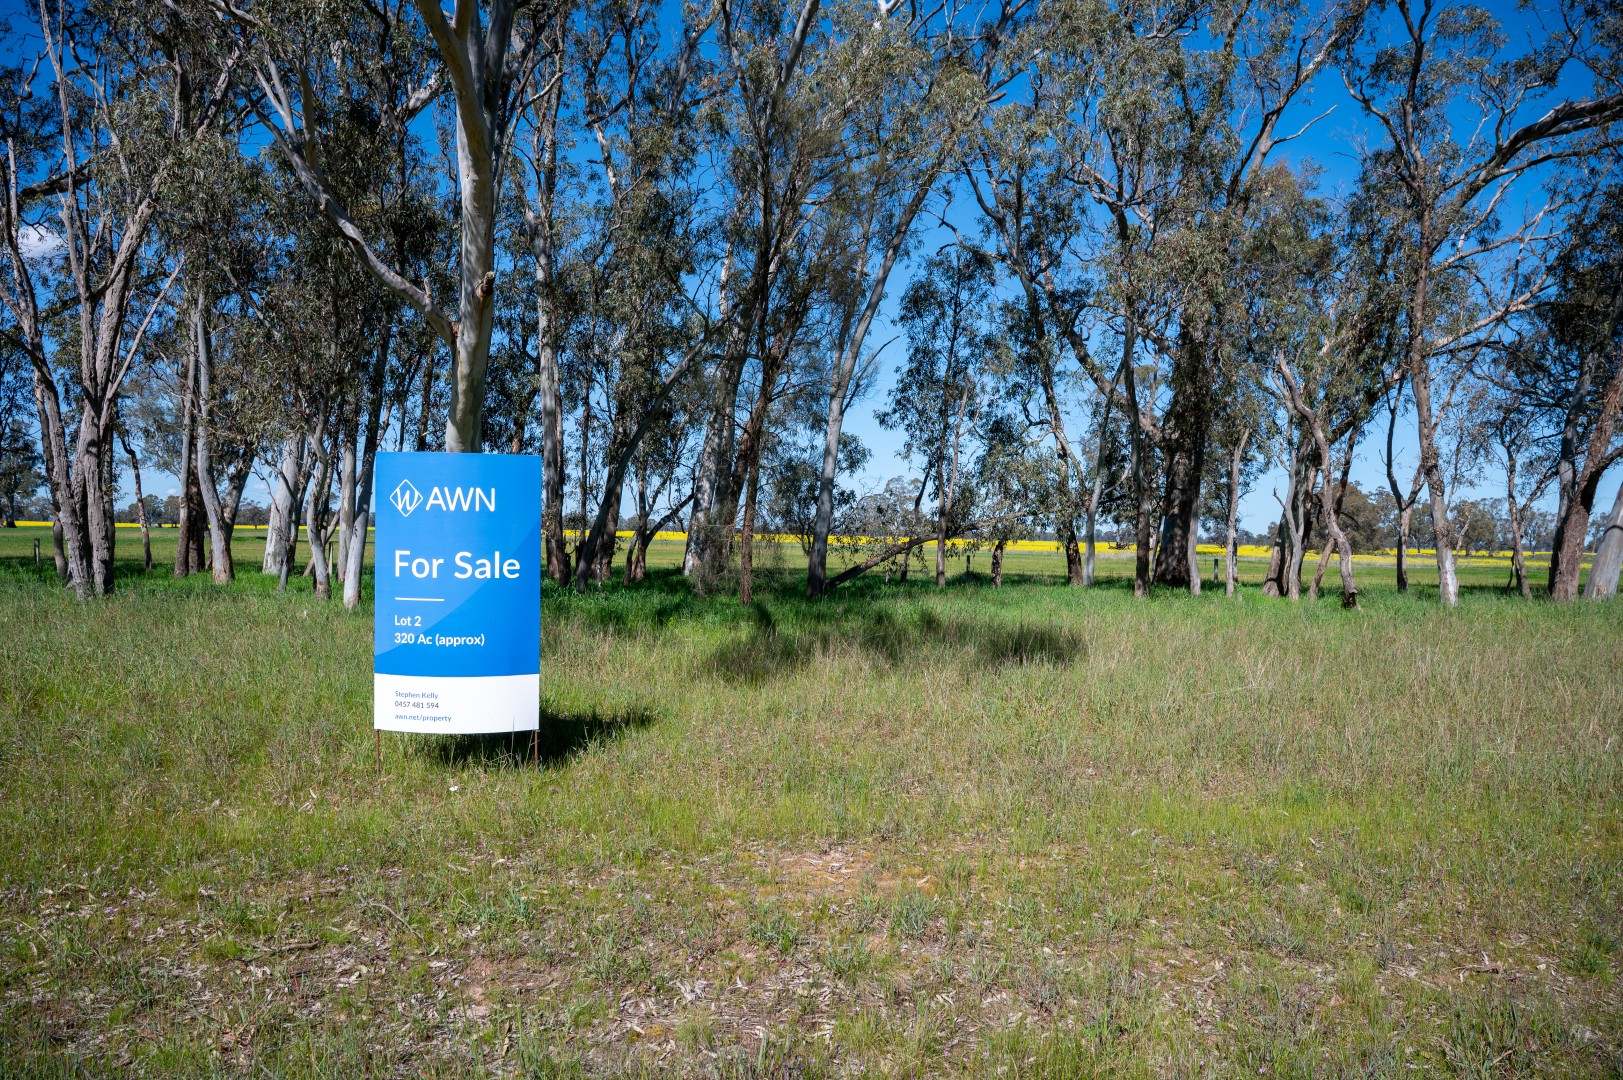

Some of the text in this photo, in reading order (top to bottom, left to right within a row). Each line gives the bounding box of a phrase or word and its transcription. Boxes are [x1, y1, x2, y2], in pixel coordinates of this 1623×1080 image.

[425, 486, 496, 512] AWN
[394, 549, 521, 579] For Sale
[394, 615, 422, 627] Lot 2
[394, 632, 485, 647] 320 Ac (approx)
[395, 690, 438, 700] Stephen Kelly
[394, 700, 411, 708] 0457
[412, 701, 424, 709] 481
